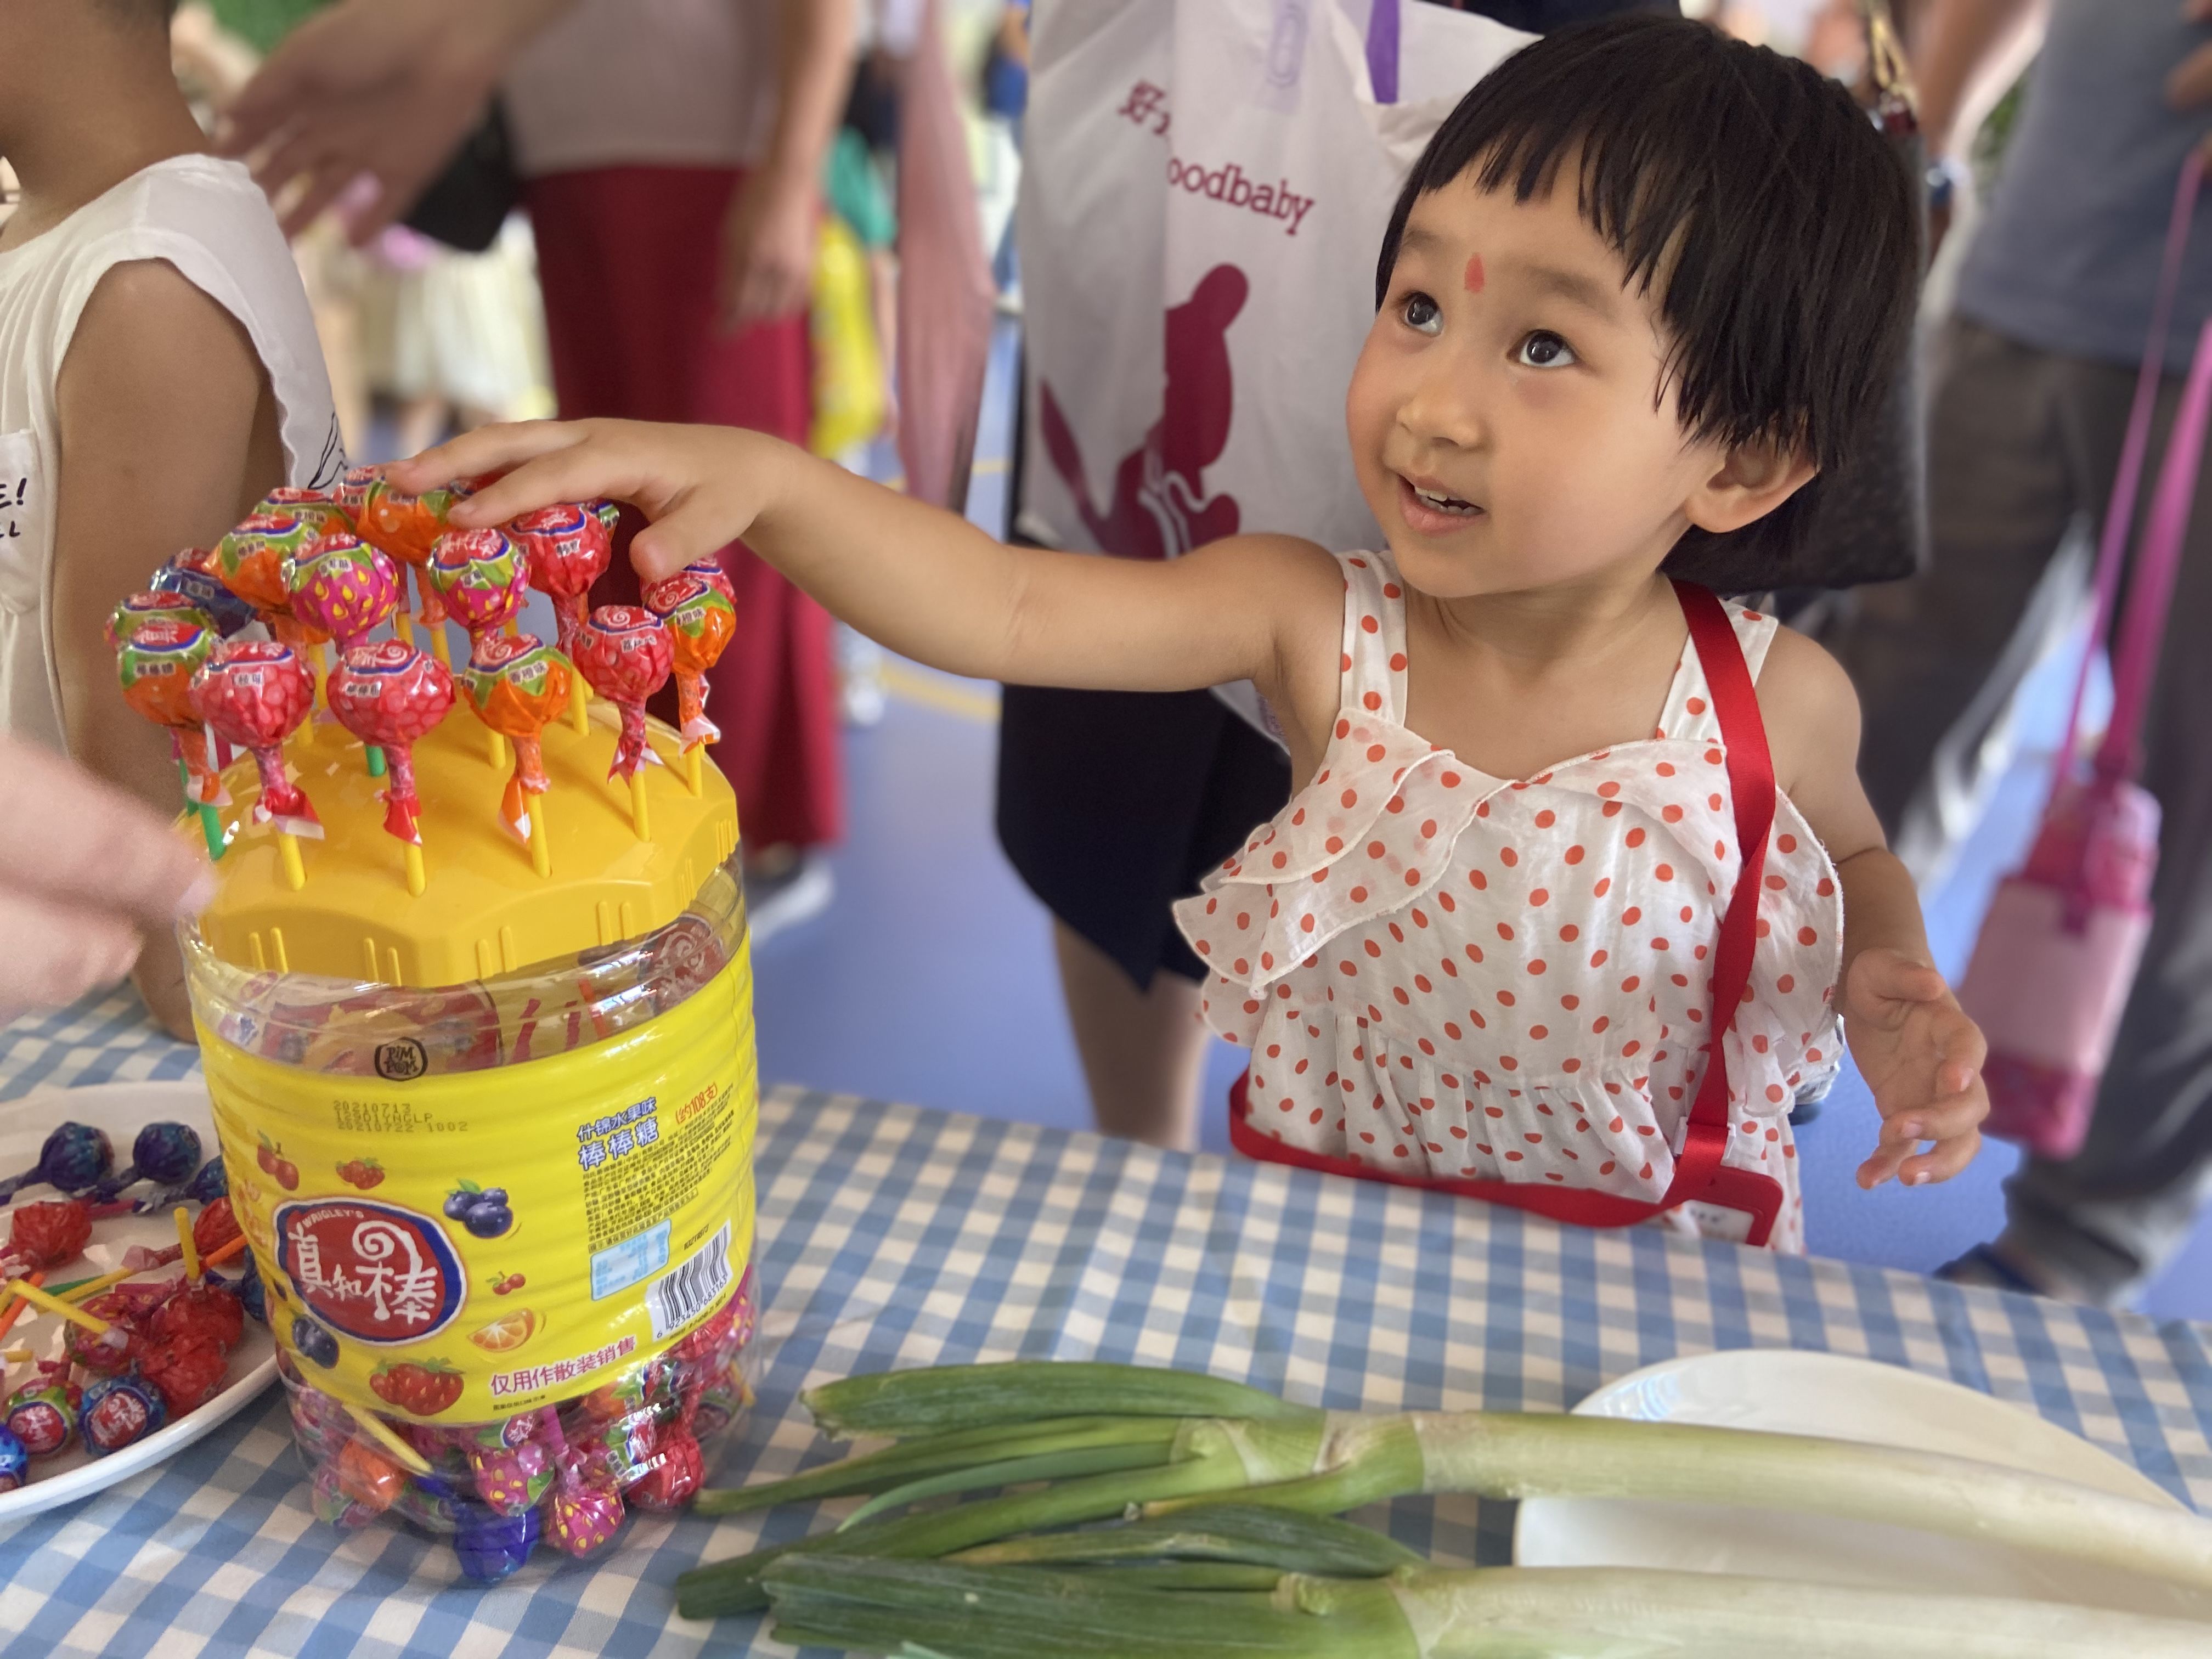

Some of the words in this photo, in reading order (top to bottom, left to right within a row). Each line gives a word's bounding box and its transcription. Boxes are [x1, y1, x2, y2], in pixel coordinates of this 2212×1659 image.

[577, 1097, 657, 1142] 什锦水果味
[578, 1116, 658, 1171] 棒棒糖
[288, 1220, 438, 1325] 真知棒
[491, 1336, 635, 1396] 仅用作散装销售
